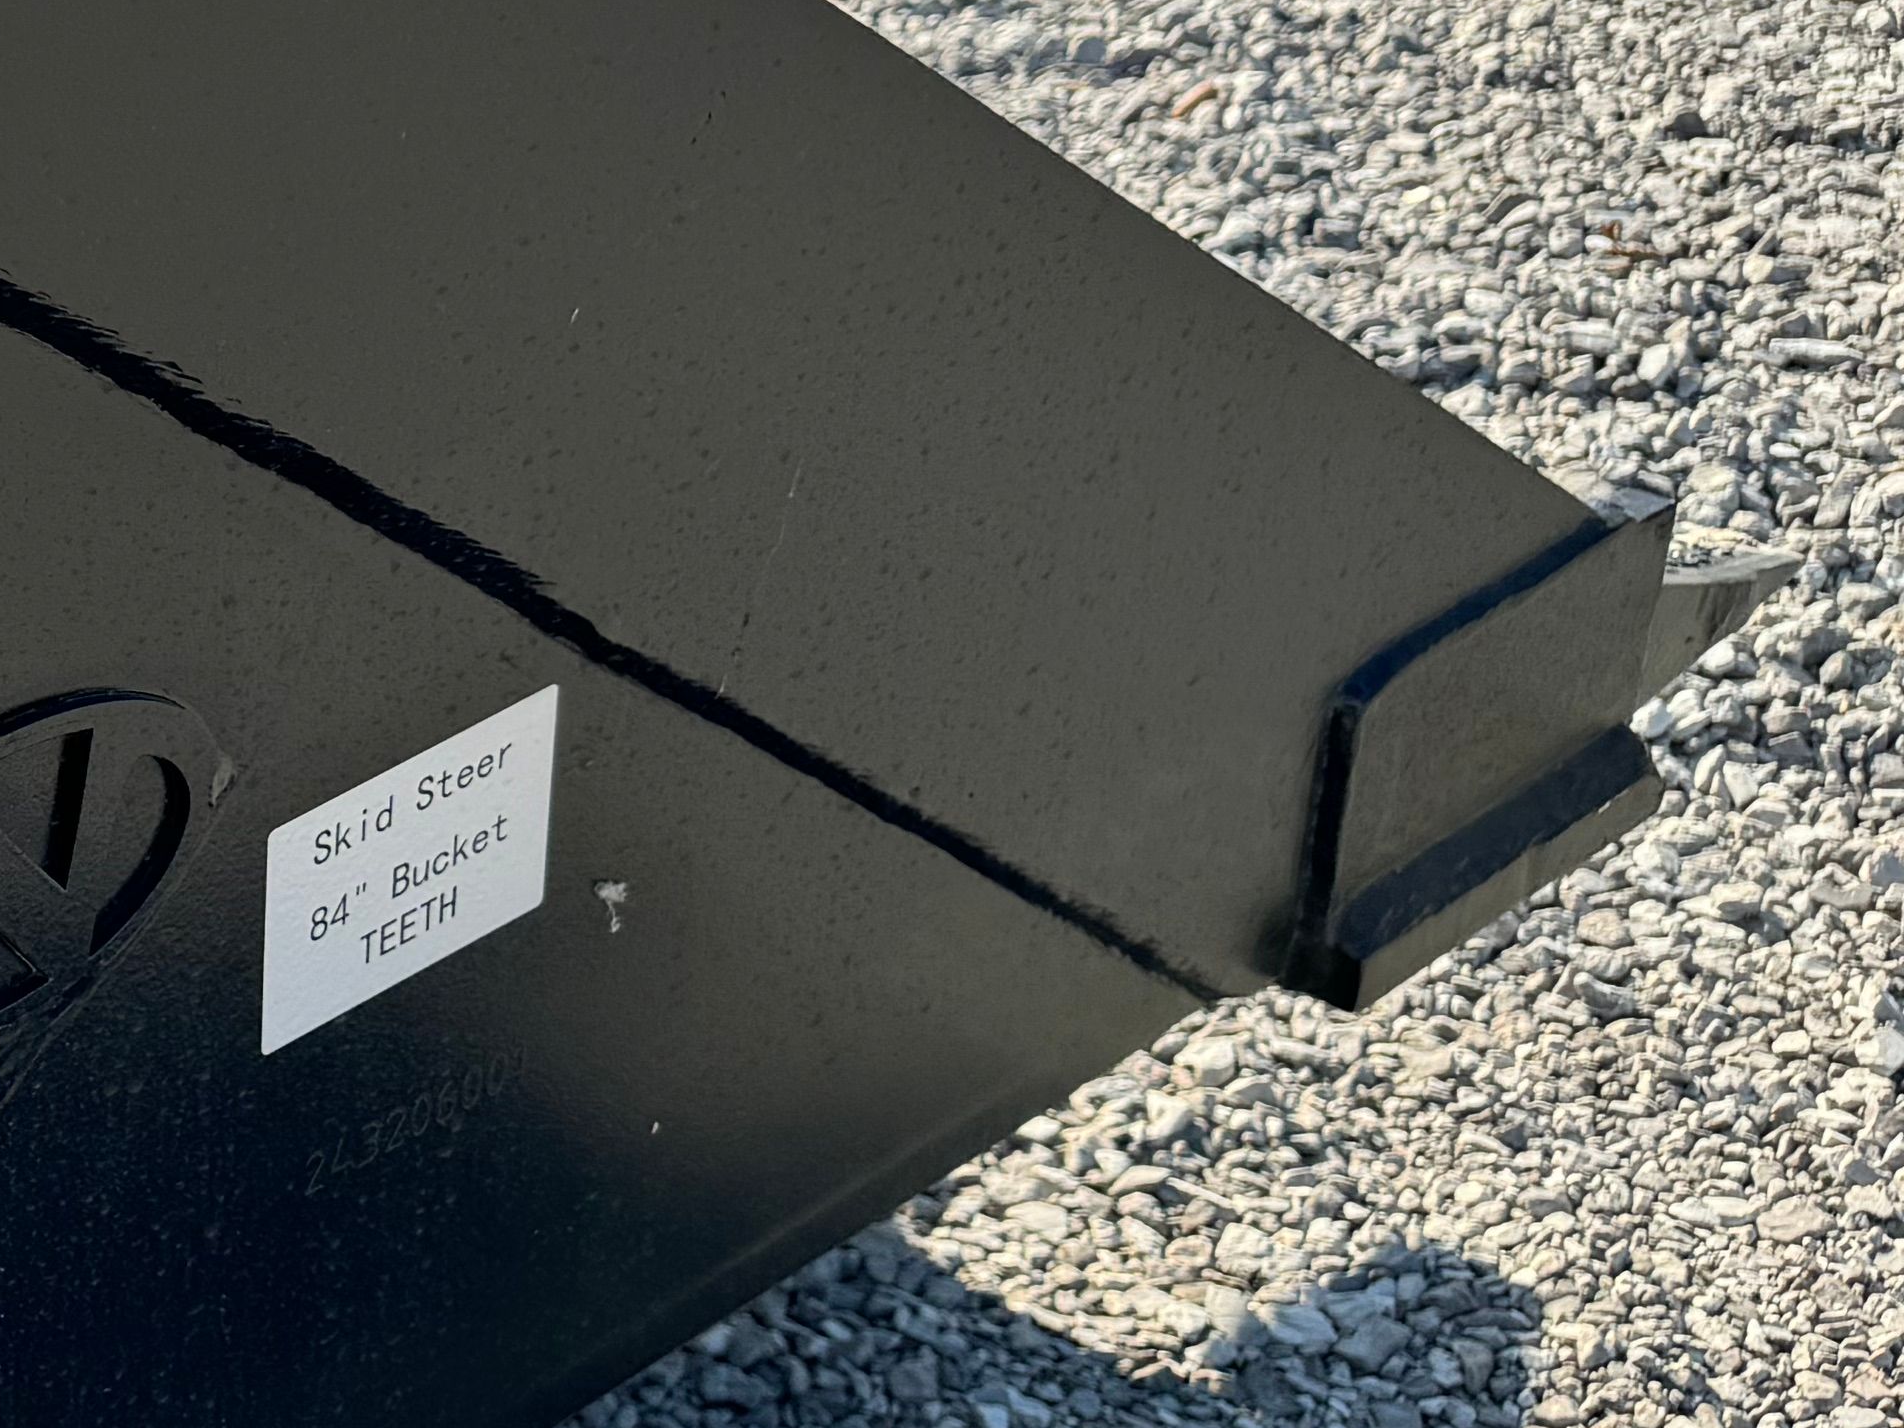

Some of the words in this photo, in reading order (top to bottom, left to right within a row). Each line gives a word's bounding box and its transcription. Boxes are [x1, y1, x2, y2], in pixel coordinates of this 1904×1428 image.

[313, 793, 395, 866] Skid
[415, 742, 514, 811] Steer
[310, 881, 367, 942] 84"
[391, 814, 509, 900] Bucket
[359, 885, 459, 965] TEETH
